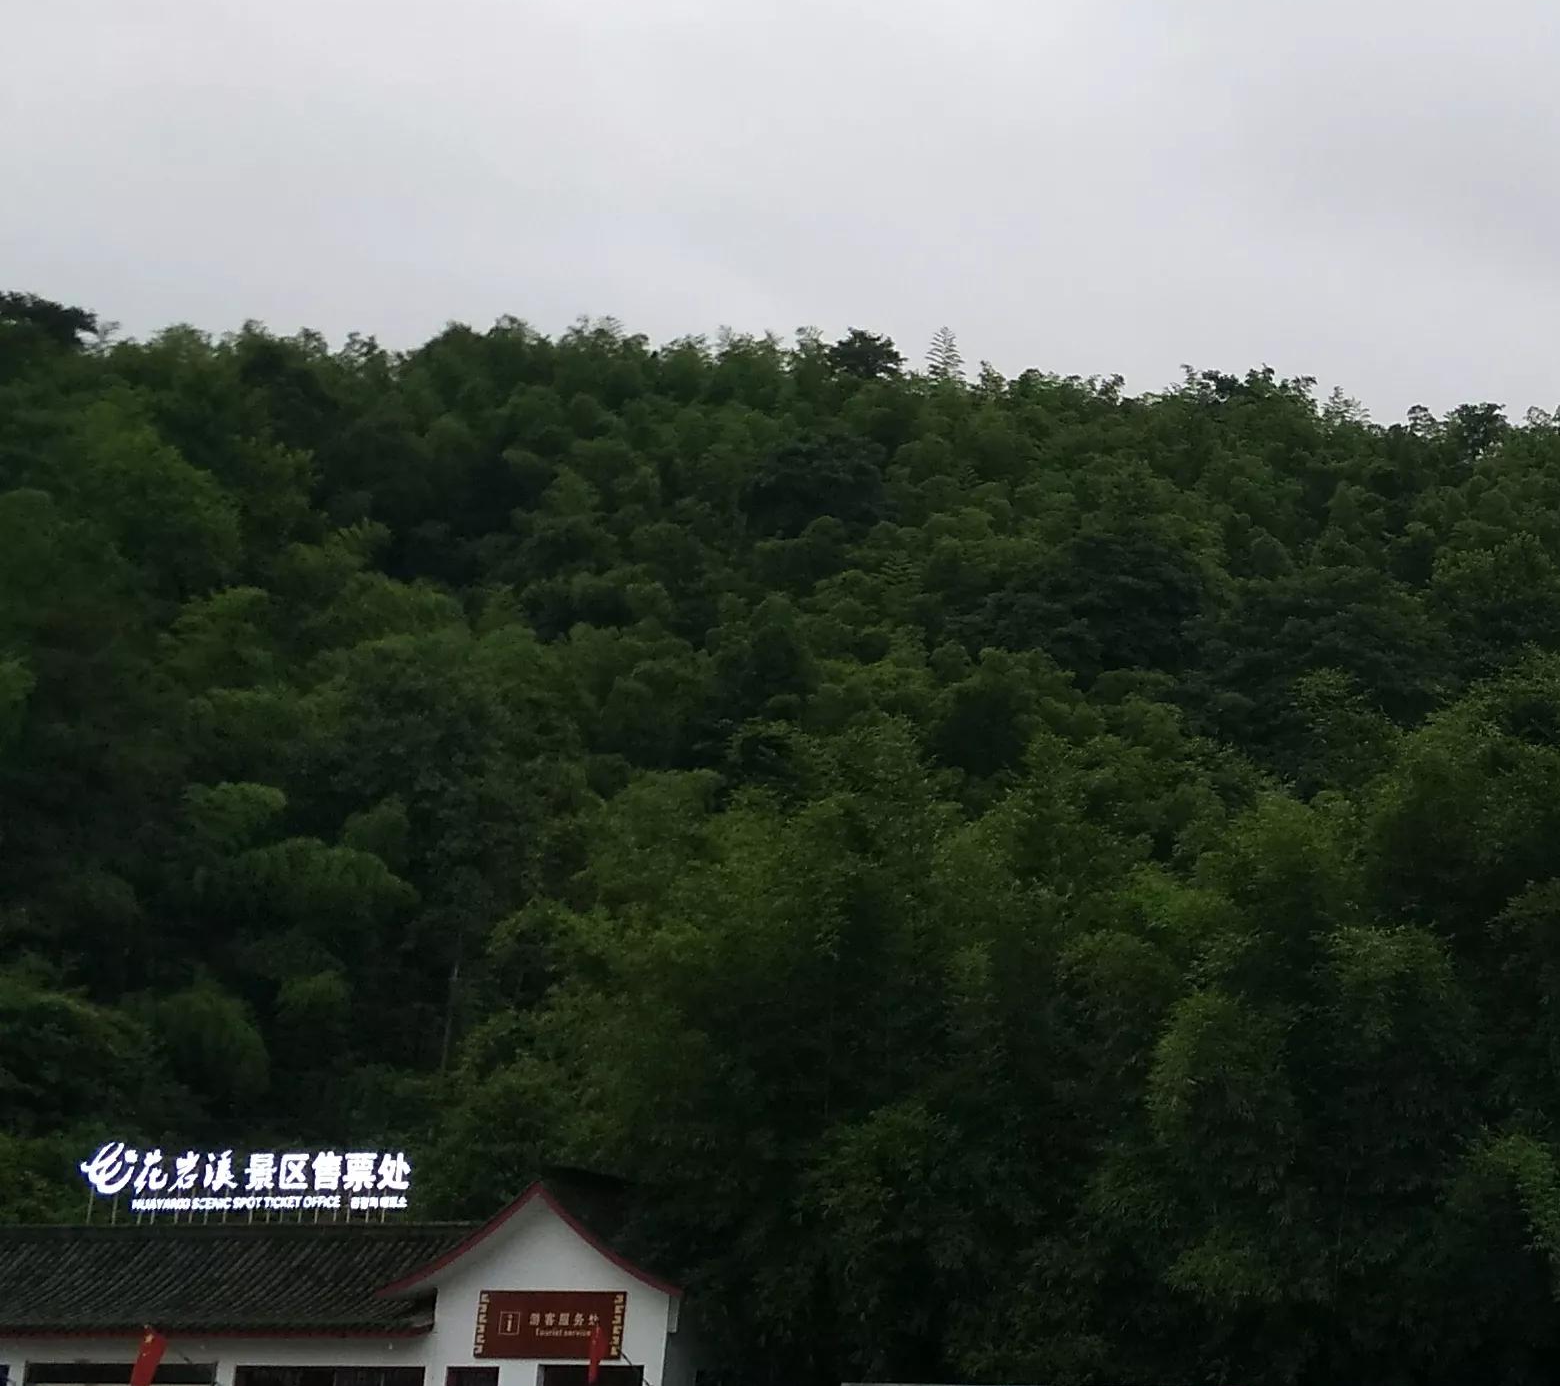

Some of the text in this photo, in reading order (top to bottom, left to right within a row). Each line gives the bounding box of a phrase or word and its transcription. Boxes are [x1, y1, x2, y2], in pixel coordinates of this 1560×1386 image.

[191, 1197, 232, 1210] SCENIC
[233, 1196, 263, 1210] SPOT
[264, 1196, 303, 1210] TICKET
[303, 1195, 341, 1209] OFFICE
